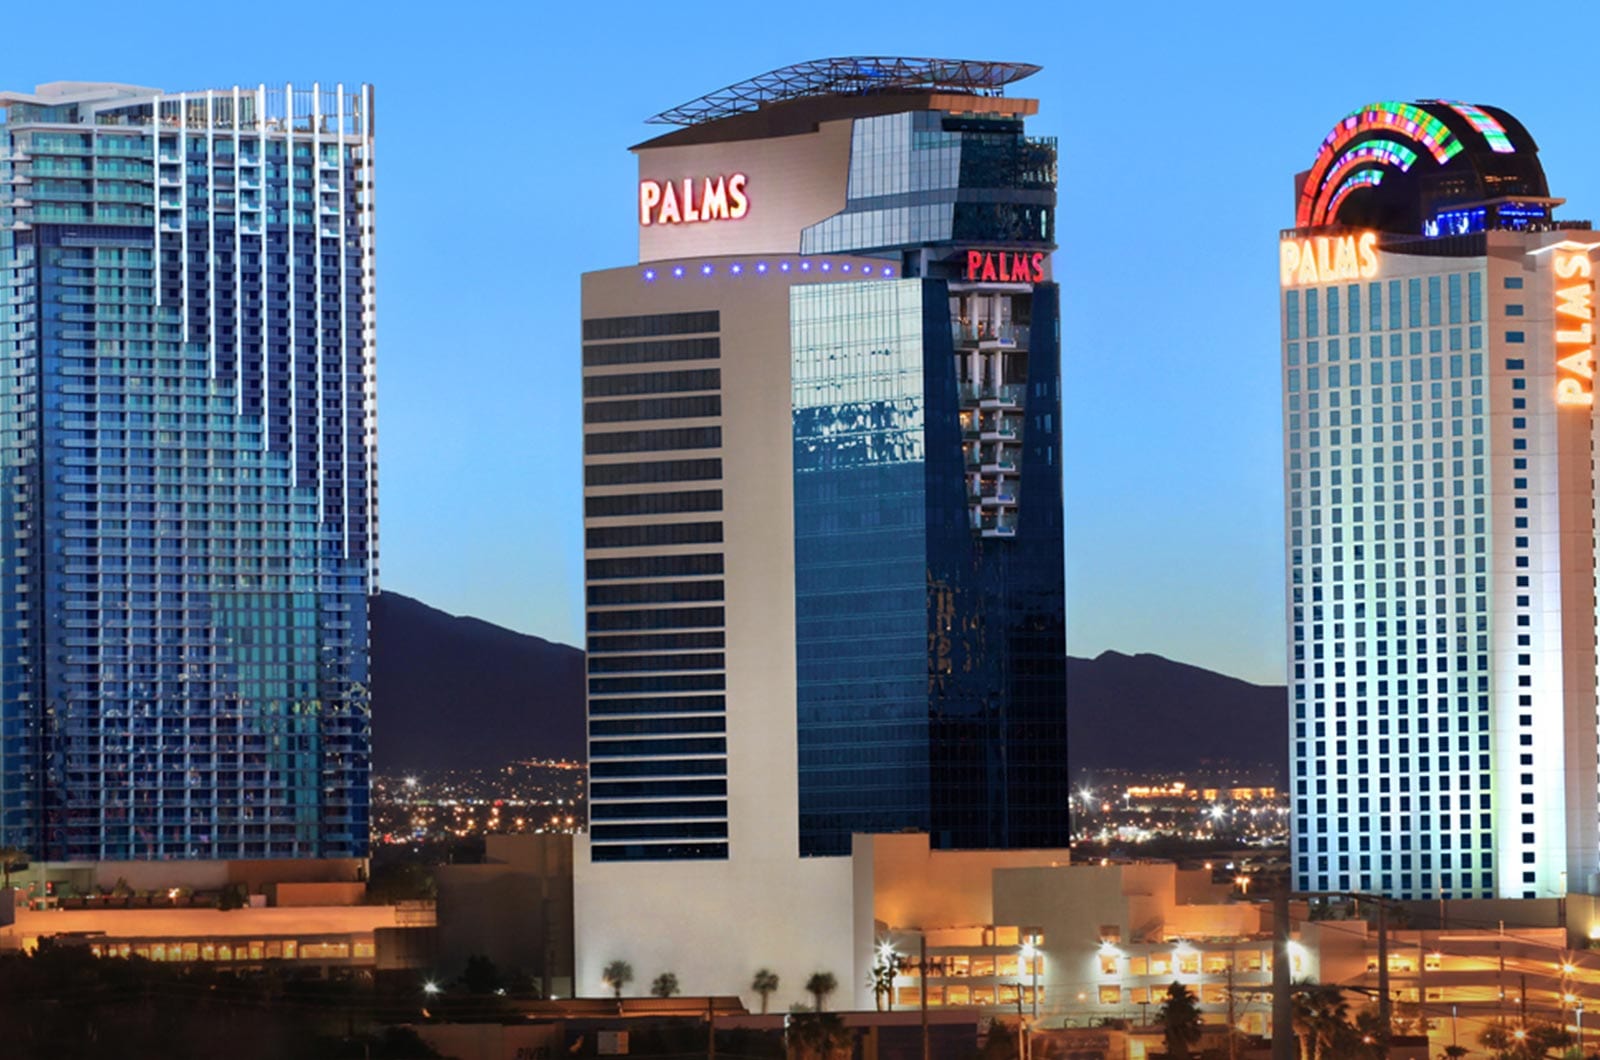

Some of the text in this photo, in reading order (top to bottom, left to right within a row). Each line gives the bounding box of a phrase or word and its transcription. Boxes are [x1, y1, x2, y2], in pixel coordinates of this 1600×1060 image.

[640, 174, 749, 225] PALMS
[967, 250, 1044, 283] PALMS
[1280, 231, 1378, 286] PALMS
[1555, 254, 1592, 405] PALMS
